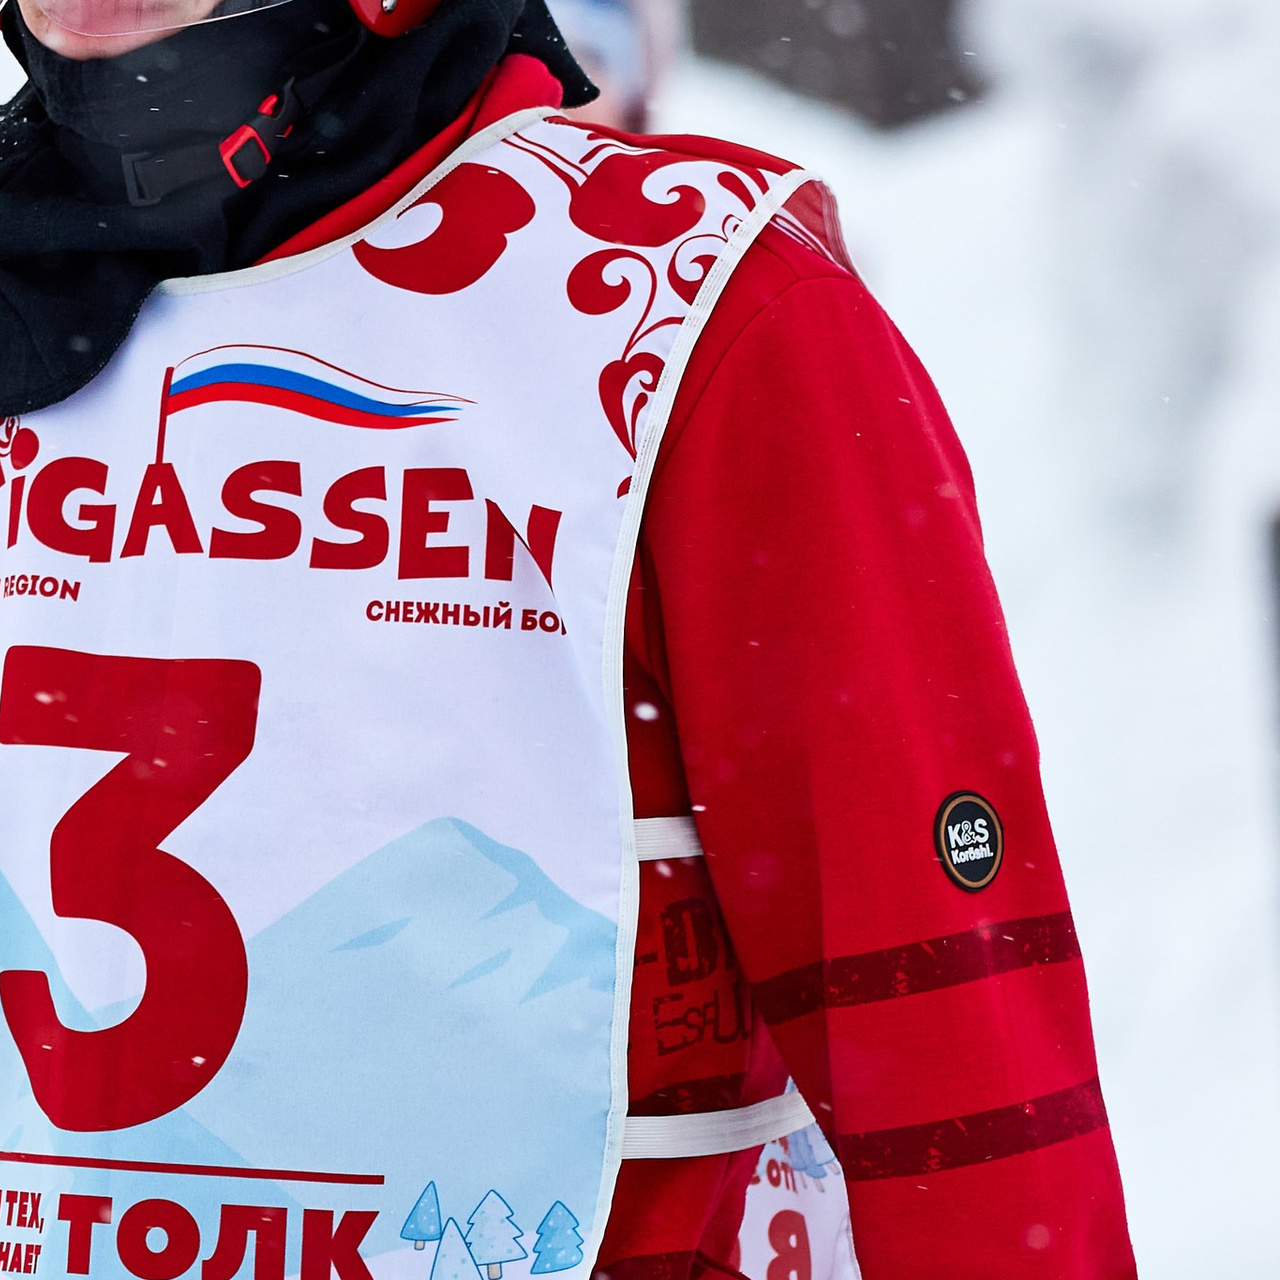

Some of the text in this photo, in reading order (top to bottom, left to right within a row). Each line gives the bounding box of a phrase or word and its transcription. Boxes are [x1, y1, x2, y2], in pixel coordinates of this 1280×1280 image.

[4, 576, 81, 603] REGION
[366, 600, 567, 635] СНЕЖНЫЙ БО
[947, 818, 990, 849] K&S
[5, 1191, 45, 1234] ТЕХ,
